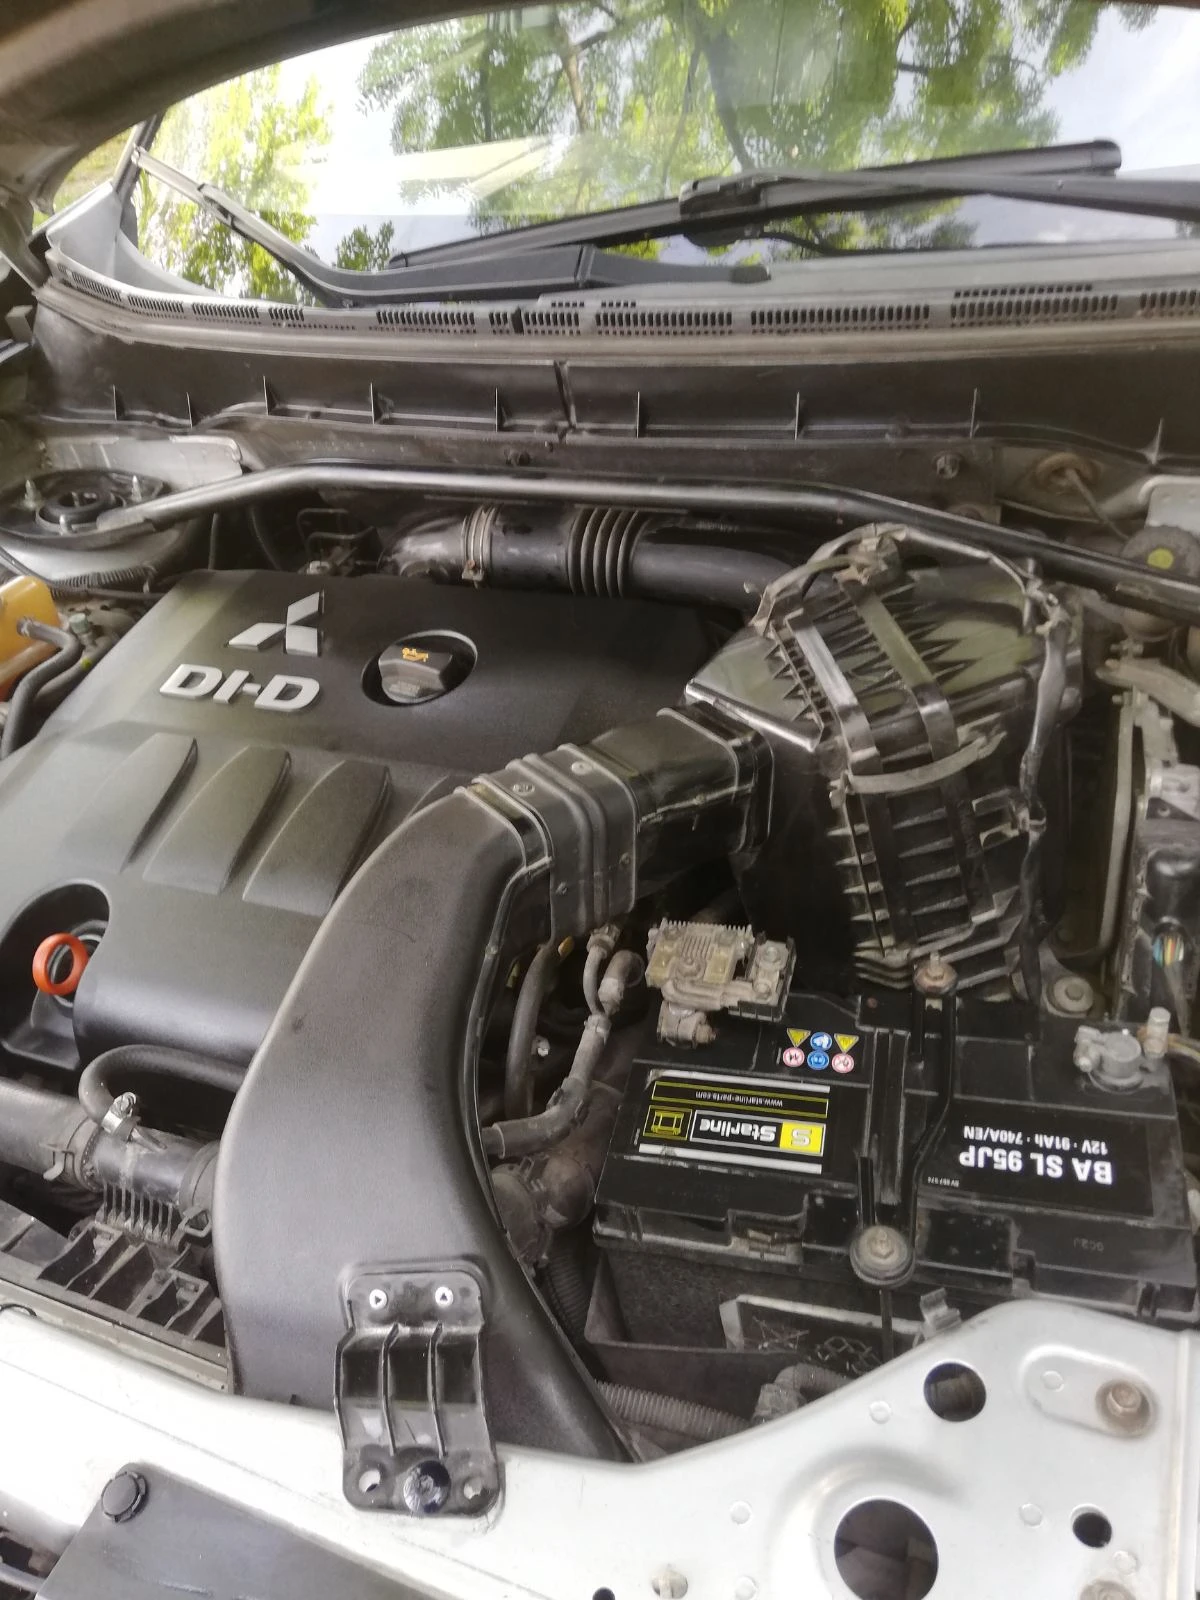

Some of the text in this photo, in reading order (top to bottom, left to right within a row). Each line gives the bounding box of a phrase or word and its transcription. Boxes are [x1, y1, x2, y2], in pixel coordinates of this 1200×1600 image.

[159, 663, 321, 712] DI-D
[695, 1090, 783, 1107] www.starline-parts.com
[699, 1117, 777, 1142] Starline
[963, 1125, 1108, 1155] 12V 91Ah 740A/EN
[959, 1144, 1113, 1185] BA SL 95JP
